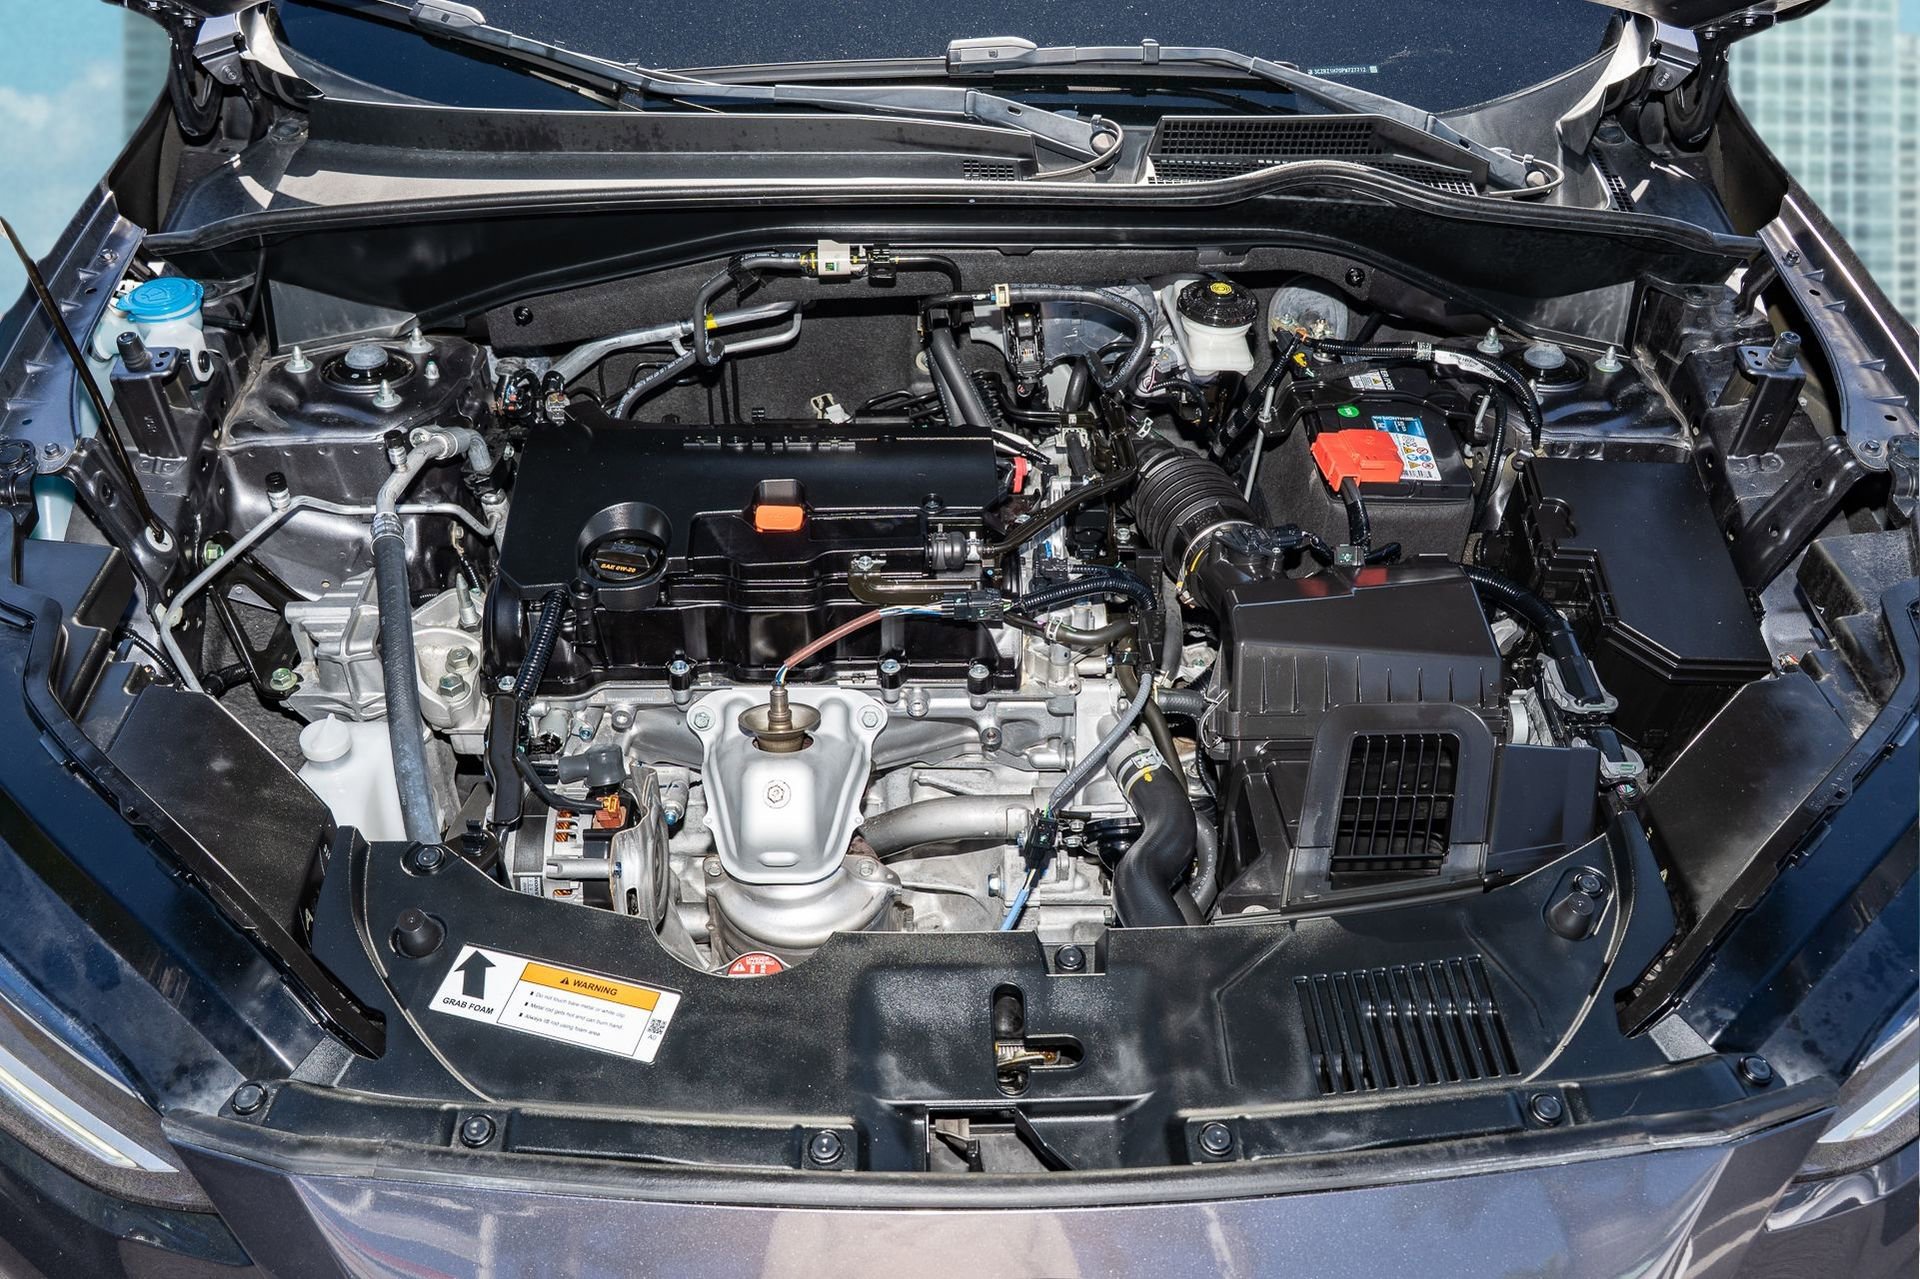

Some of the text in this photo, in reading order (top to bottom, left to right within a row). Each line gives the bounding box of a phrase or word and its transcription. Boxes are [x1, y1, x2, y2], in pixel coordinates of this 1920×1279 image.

[573, 979, 618, 996] WARNING
[443, 997, 494, 1014] GRAB FOAM
